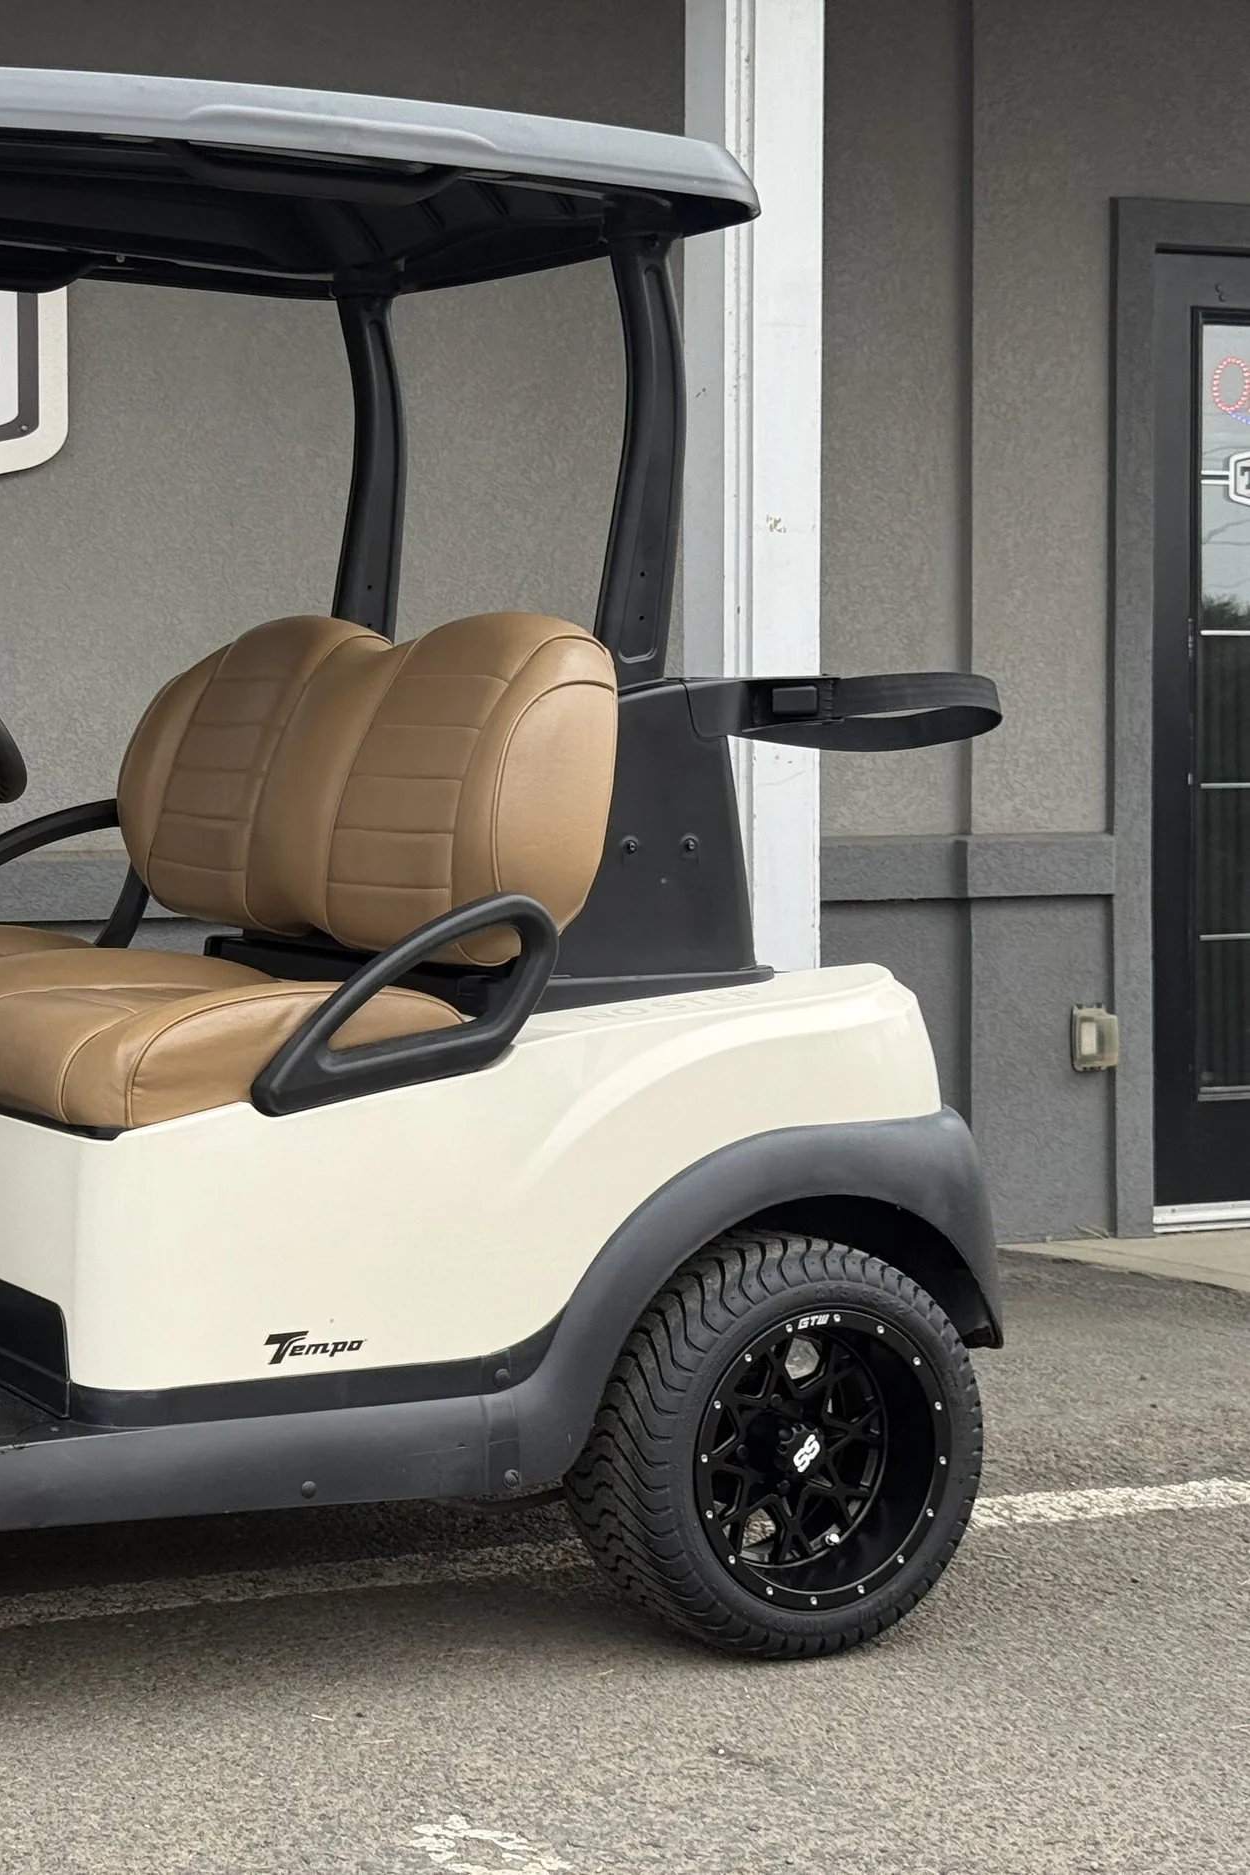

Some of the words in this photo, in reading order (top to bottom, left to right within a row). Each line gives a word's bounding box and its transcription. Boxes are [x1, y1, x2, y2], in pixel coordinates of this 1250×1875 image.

[575, 1006, 648, 1022] NO
[652, 989, 758, 1010] STEP
[797, 1313, 830, 1330] GTW
[264, 1330, 364, 1365] Tempo
